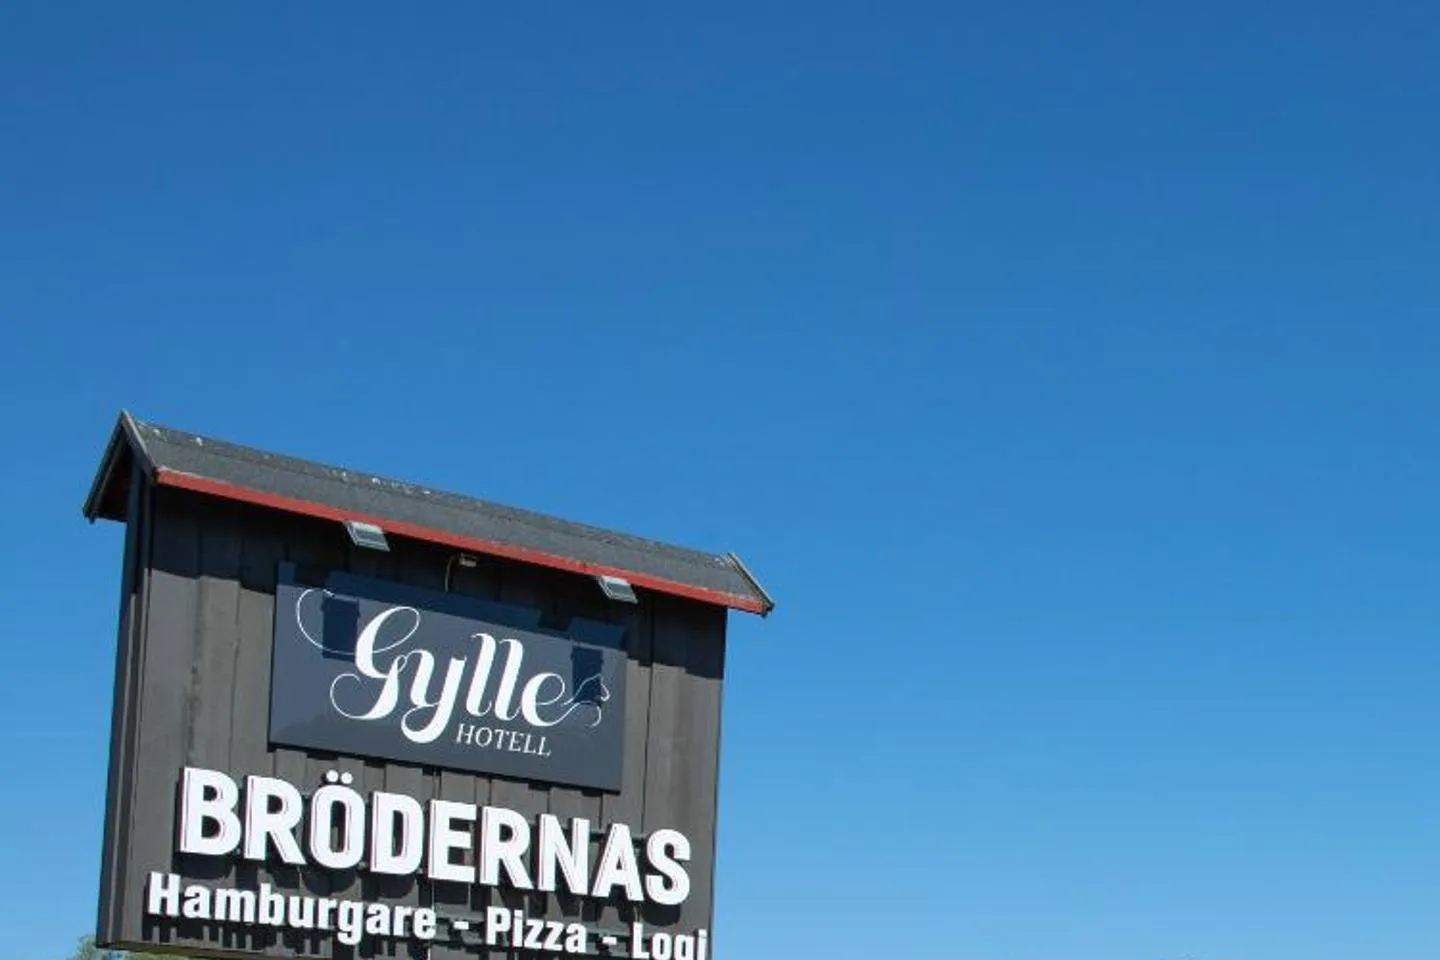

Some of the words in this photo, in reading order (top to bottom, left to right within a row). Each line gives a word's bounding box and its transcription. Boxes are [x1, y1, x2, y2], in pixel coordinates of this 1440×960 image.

[296, 588, 610, 743] Gylle
[456, 723, 551, 757] HOTELL
[179, 766, 690, 905] BRÖDERNAS
[148, 871, 436, 945] Hamburgare
[486, 906, 586, 953] Pizza
